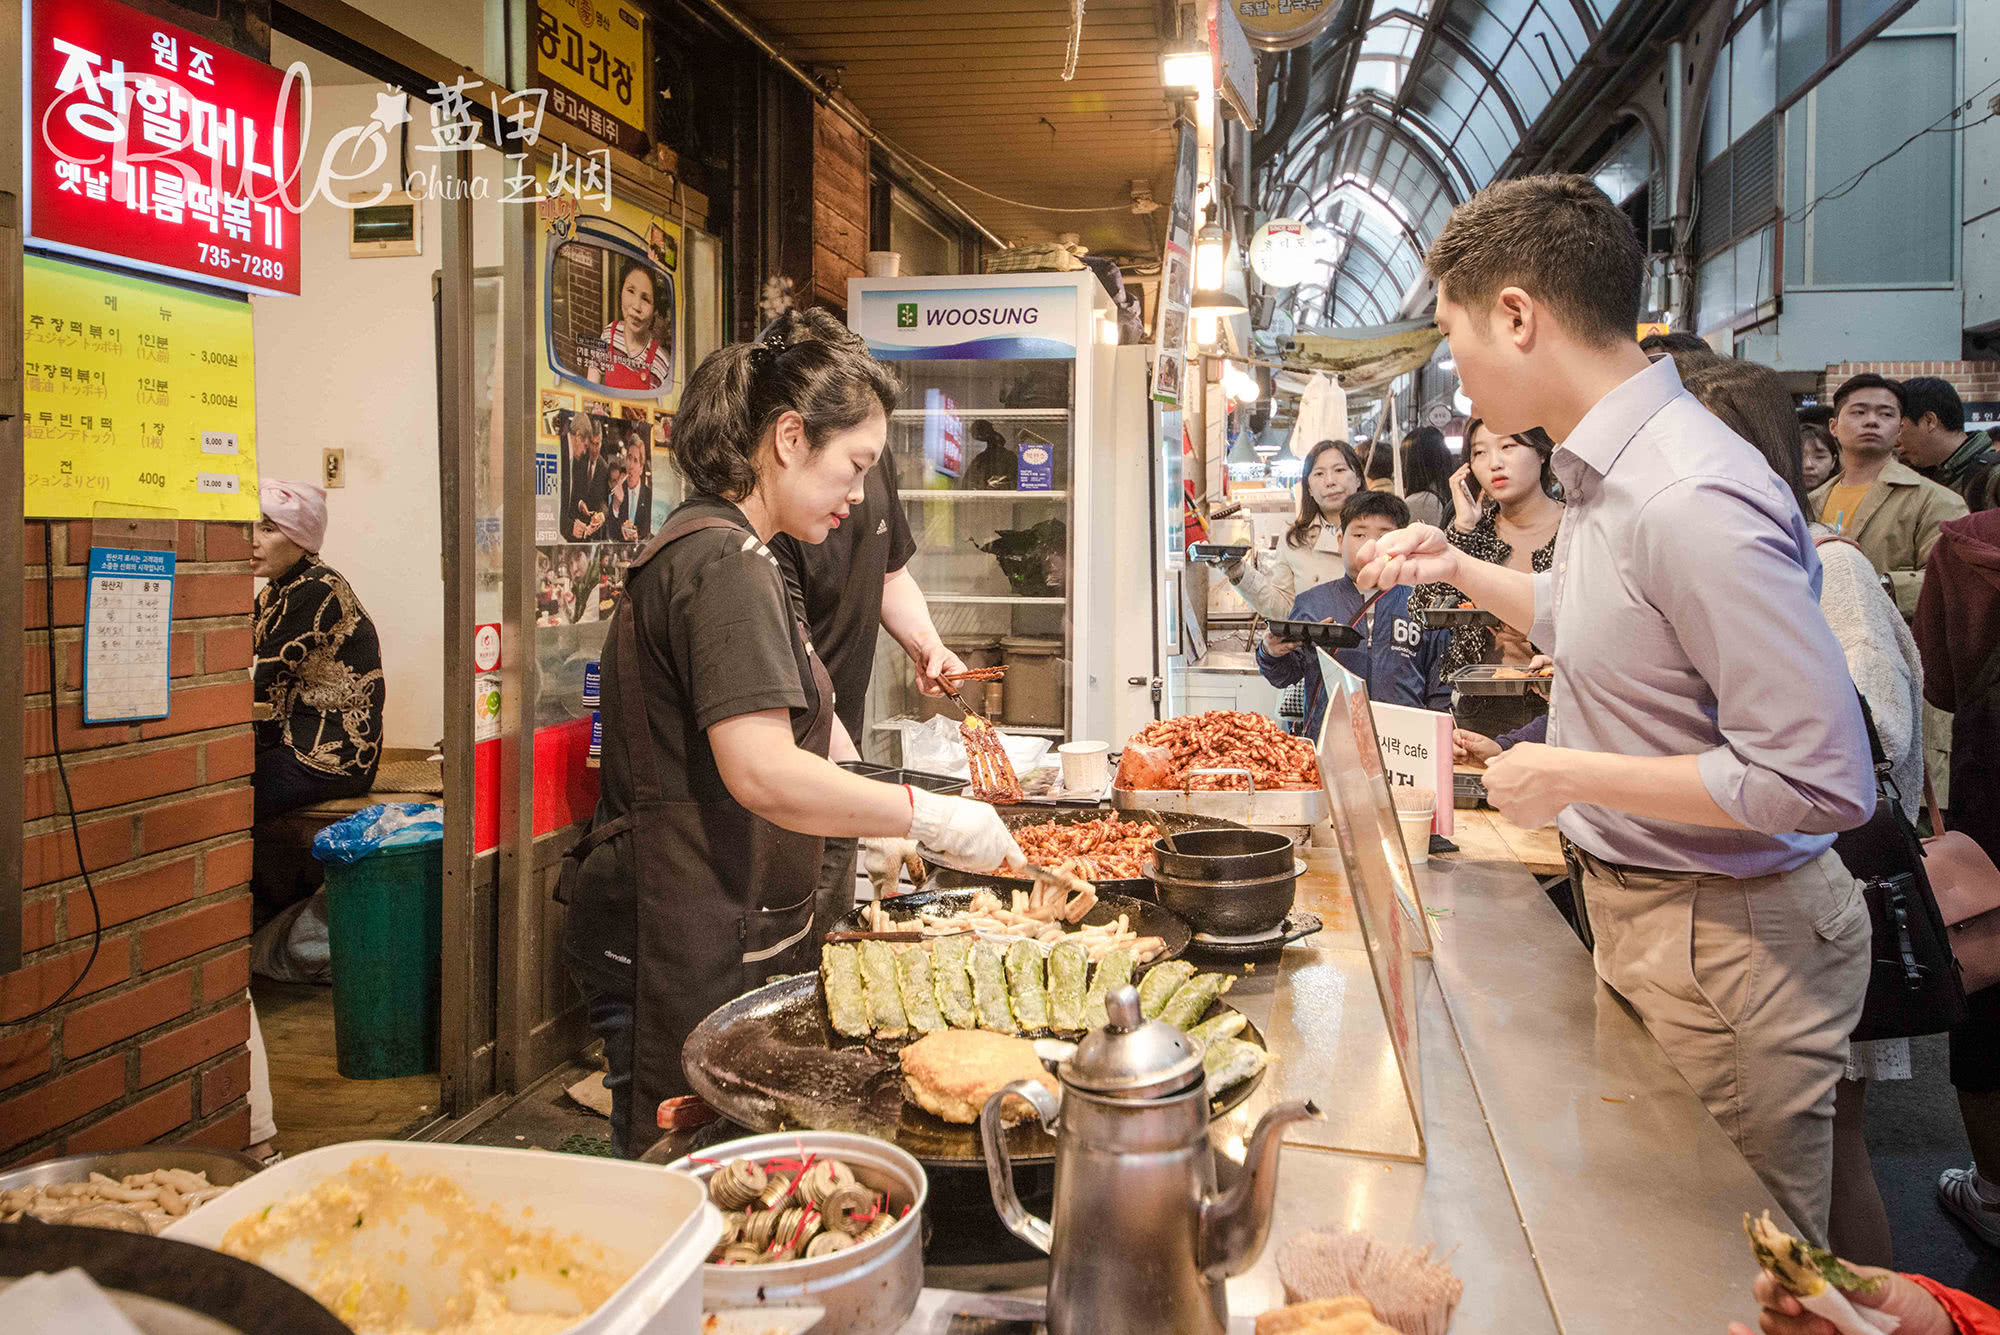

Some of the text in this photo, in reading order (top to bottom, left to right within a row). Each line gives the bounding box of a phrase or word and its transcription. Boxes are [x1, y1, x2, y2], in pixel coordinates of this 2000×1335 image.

[151, 31, 215, 86] 원조
[537, 8, 633, 106] 몽고간장
[53, 37, 284, 184] 정할머니
[55, 160, 110, 202] 옛날
[197, 243, 284, 281] 735-7289
[926, 307, 1039, 326] WOOSUNG
[137, 333, 169, 350] 1인분
[201, 350, 238, 368] 3,000원
[25, 361, 238, 409] 간장떡볶이 1인분 3,000원
[60, 459, 73, 475] 전
[138, 472, 166, 488] 400g
[202, 479, 222, 488] 12,000
[101, 580, 123, 592] 원산지
[1393, 618, 1421, 646] 66
[1403, 743, 1428, 760] cafe
